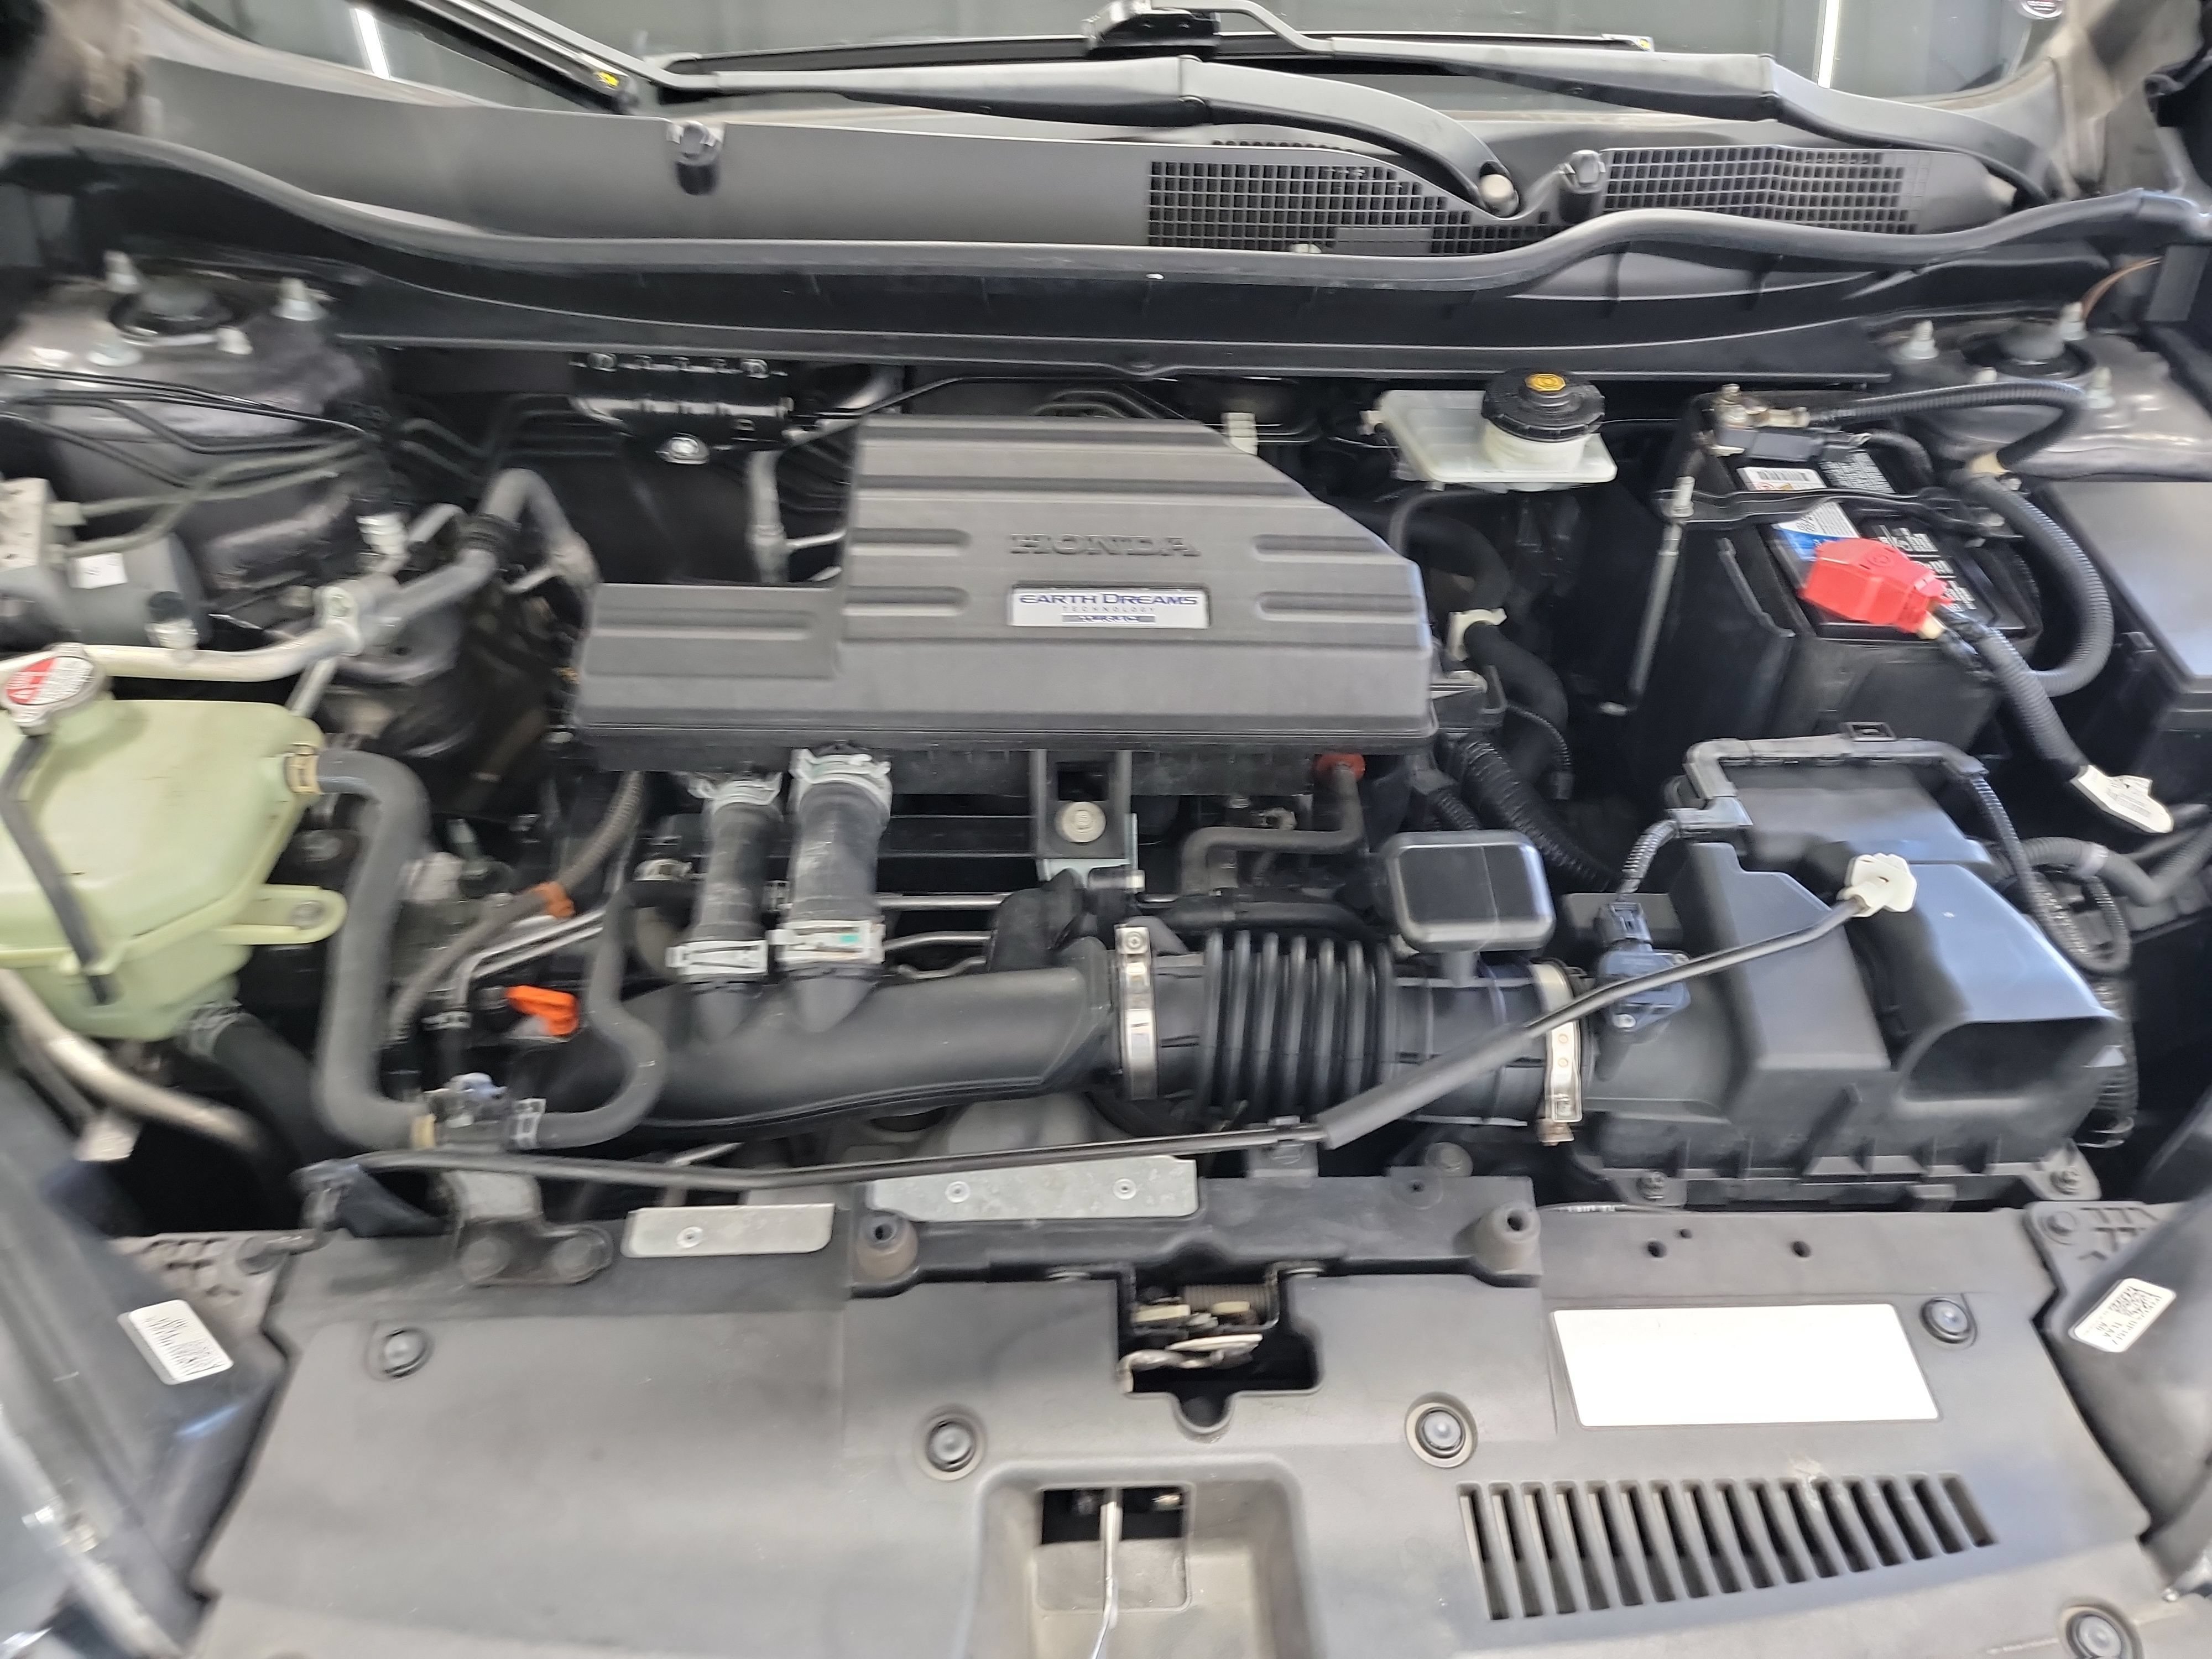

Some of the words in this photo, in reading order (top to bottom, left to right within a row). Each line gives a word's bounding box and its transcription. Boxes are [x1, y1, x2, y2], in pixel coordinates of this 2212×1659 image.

[1010, 534, 1201, 557] HONDA
[1019, 594, 1097, 604] EARTH
[1102, 593, 1199, 604] DREAMS
